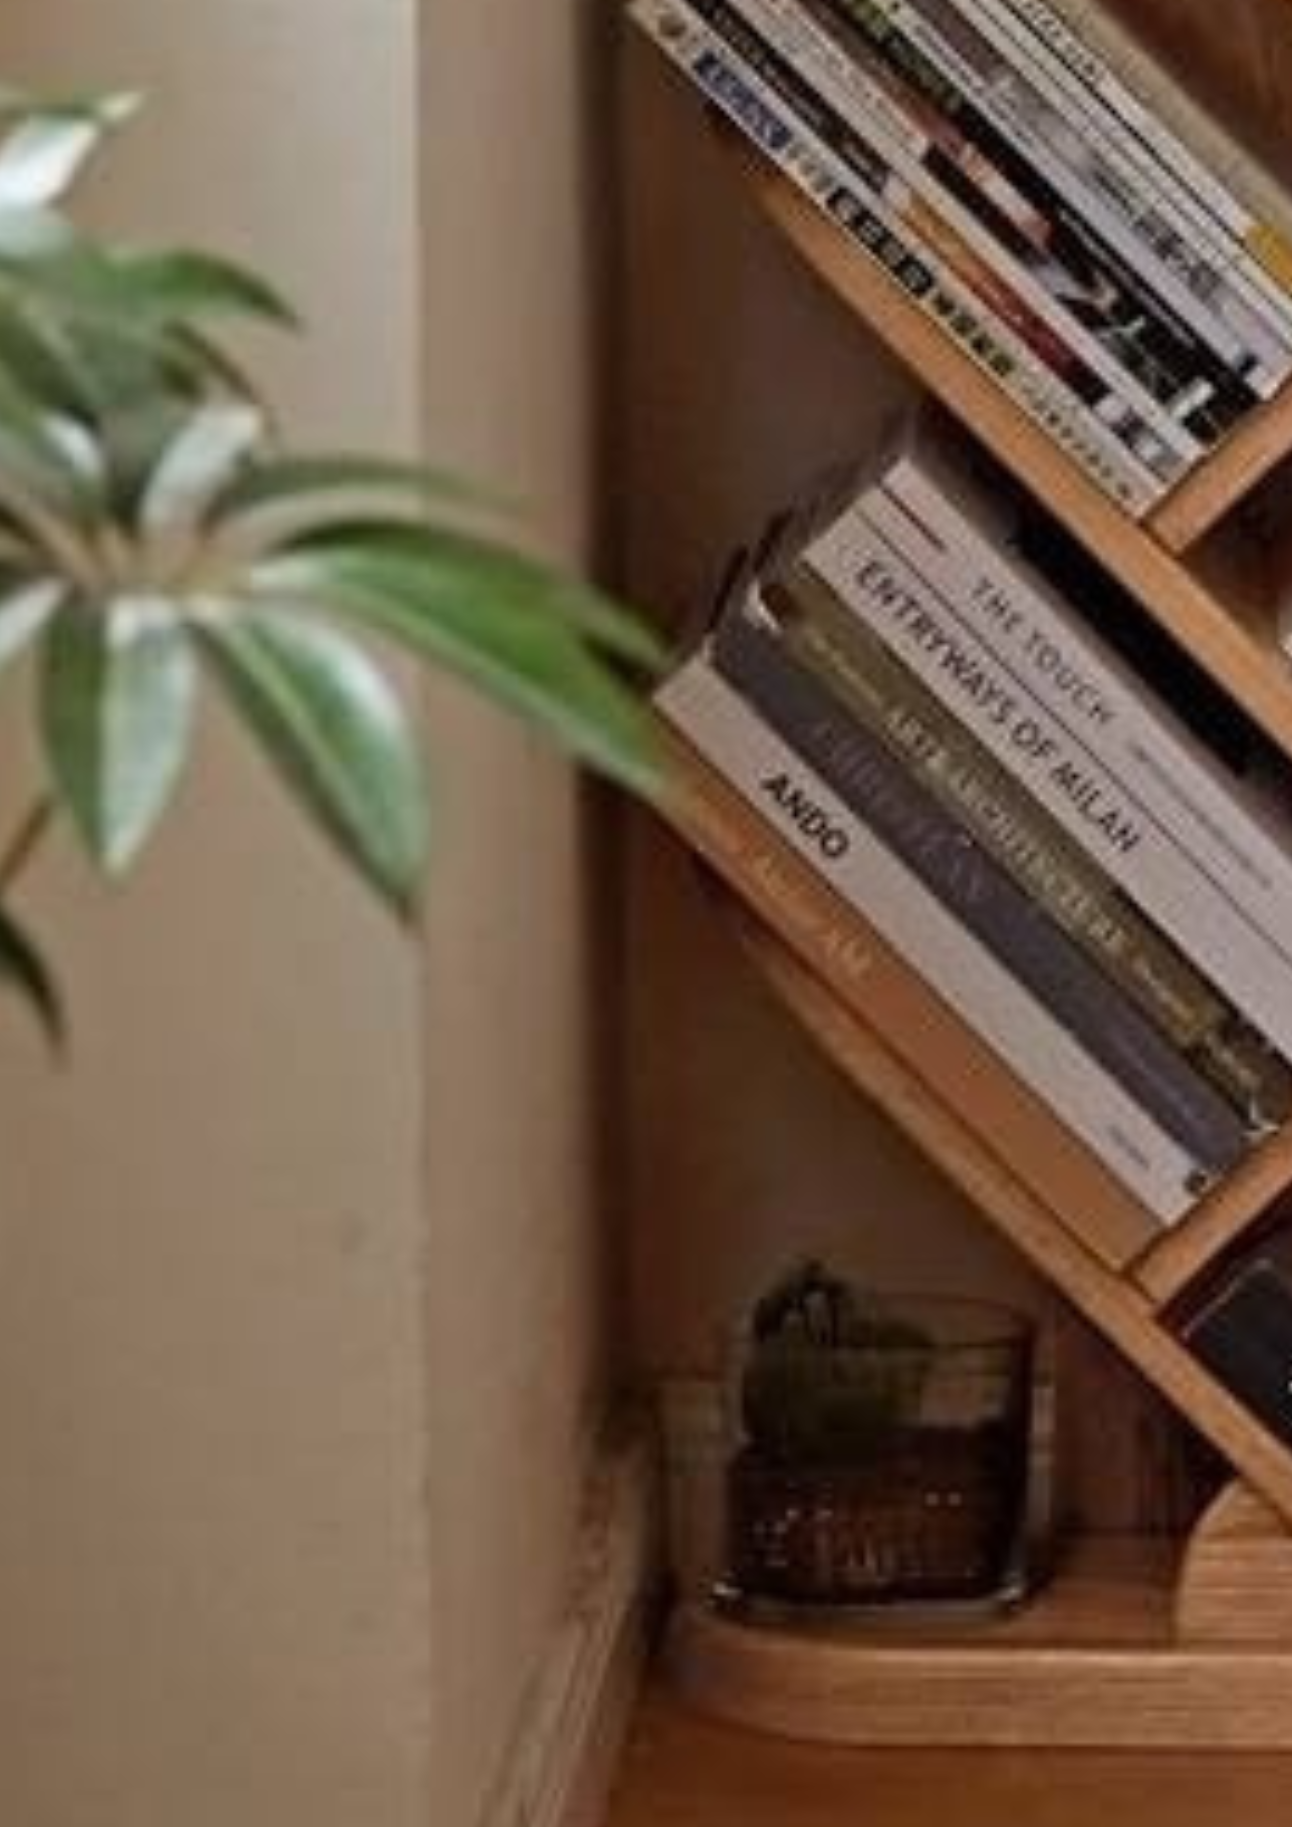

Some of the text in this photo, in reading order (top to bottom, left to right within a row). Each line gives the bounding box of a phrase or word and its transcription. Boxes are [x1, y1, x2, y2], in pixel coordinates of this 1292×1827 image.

[853, 558, 1014, 729] ENTRYWAYS
[1010, 719, 1057, 766] OF
[1048, 764, 1143, 856] MILAN
[968, 575, 1117, 726] THE TOUCH
[760, 771, 854, 863] ANDO
